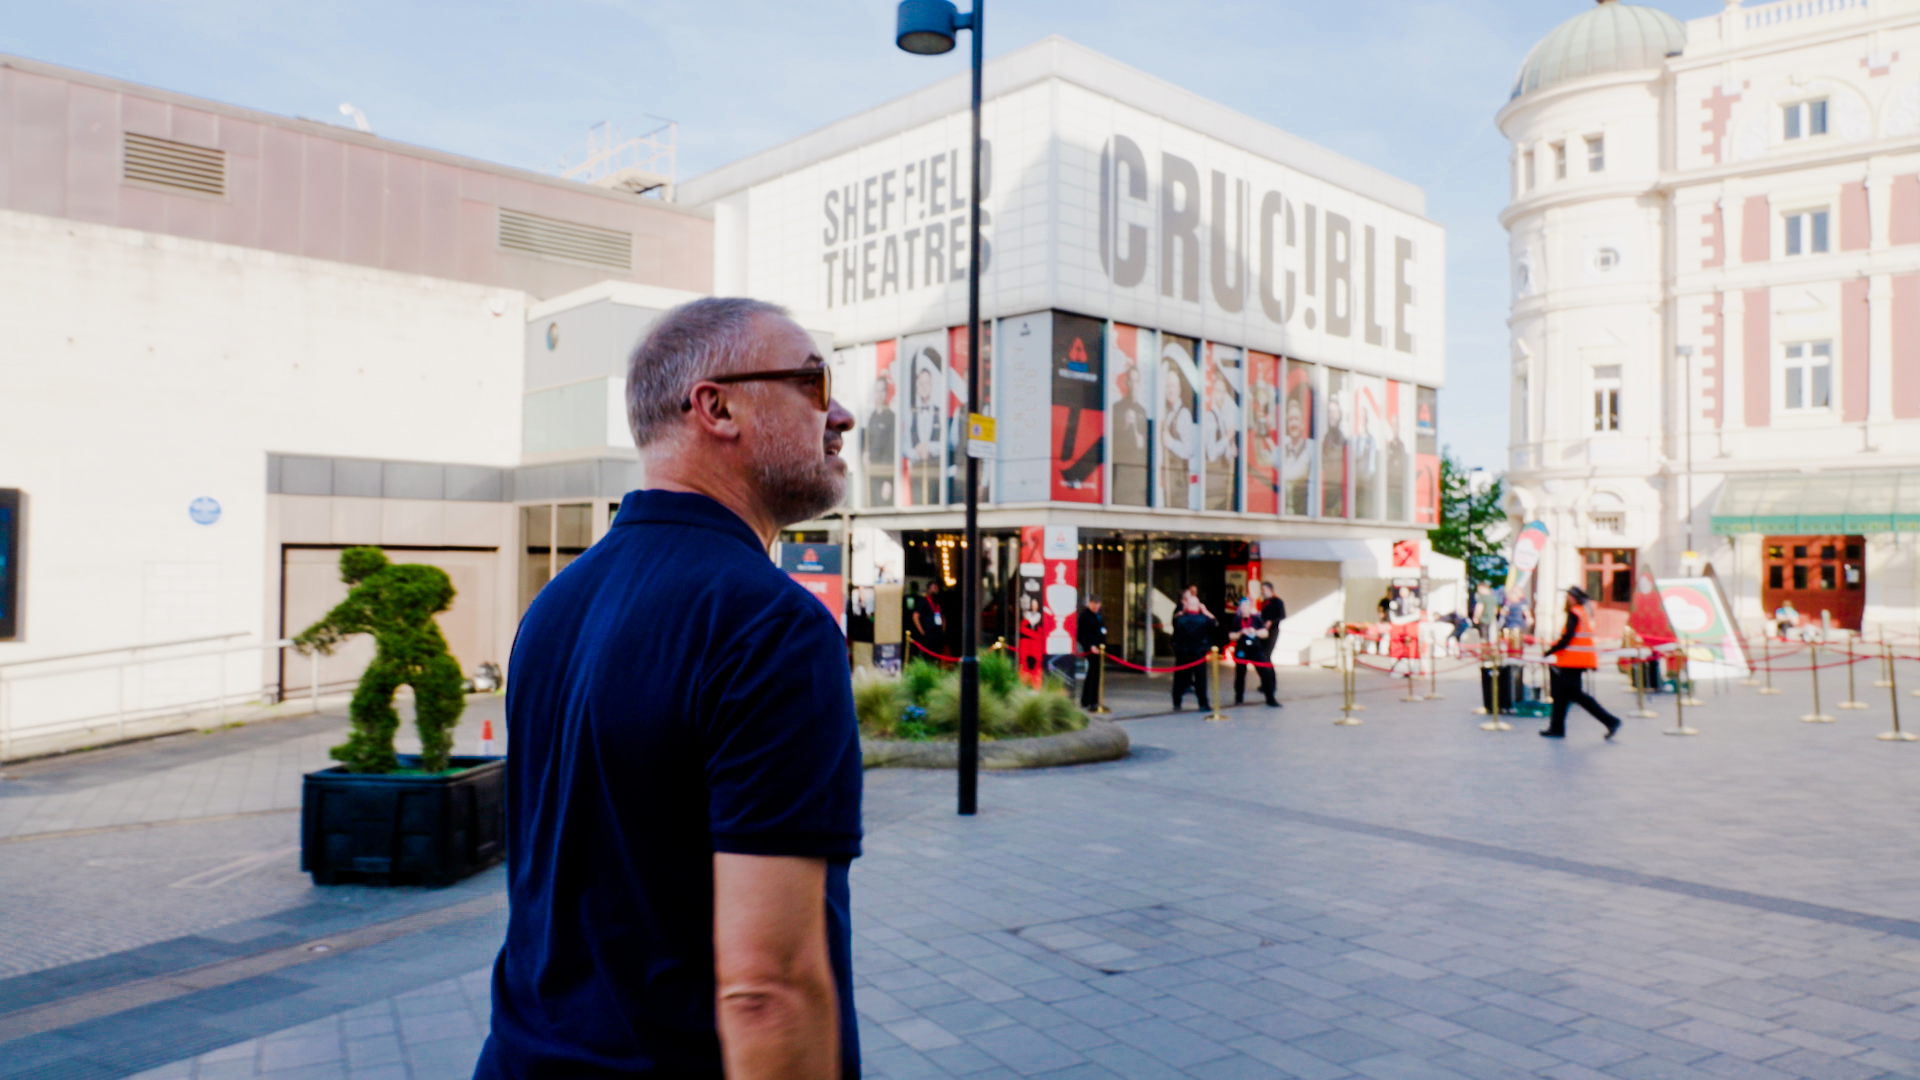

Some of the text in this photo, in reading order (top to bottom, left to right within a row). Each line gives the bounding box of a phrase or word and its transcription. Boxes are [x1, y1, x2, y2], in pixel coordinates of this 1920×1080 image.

[822, 207, 992, 308] THEATRES
[1099, 134, 1416, 355] CRUC!BLE
[1012, 345, 1025, 454] CENTURY
[1024, 368, 1037, 430] CLUB
